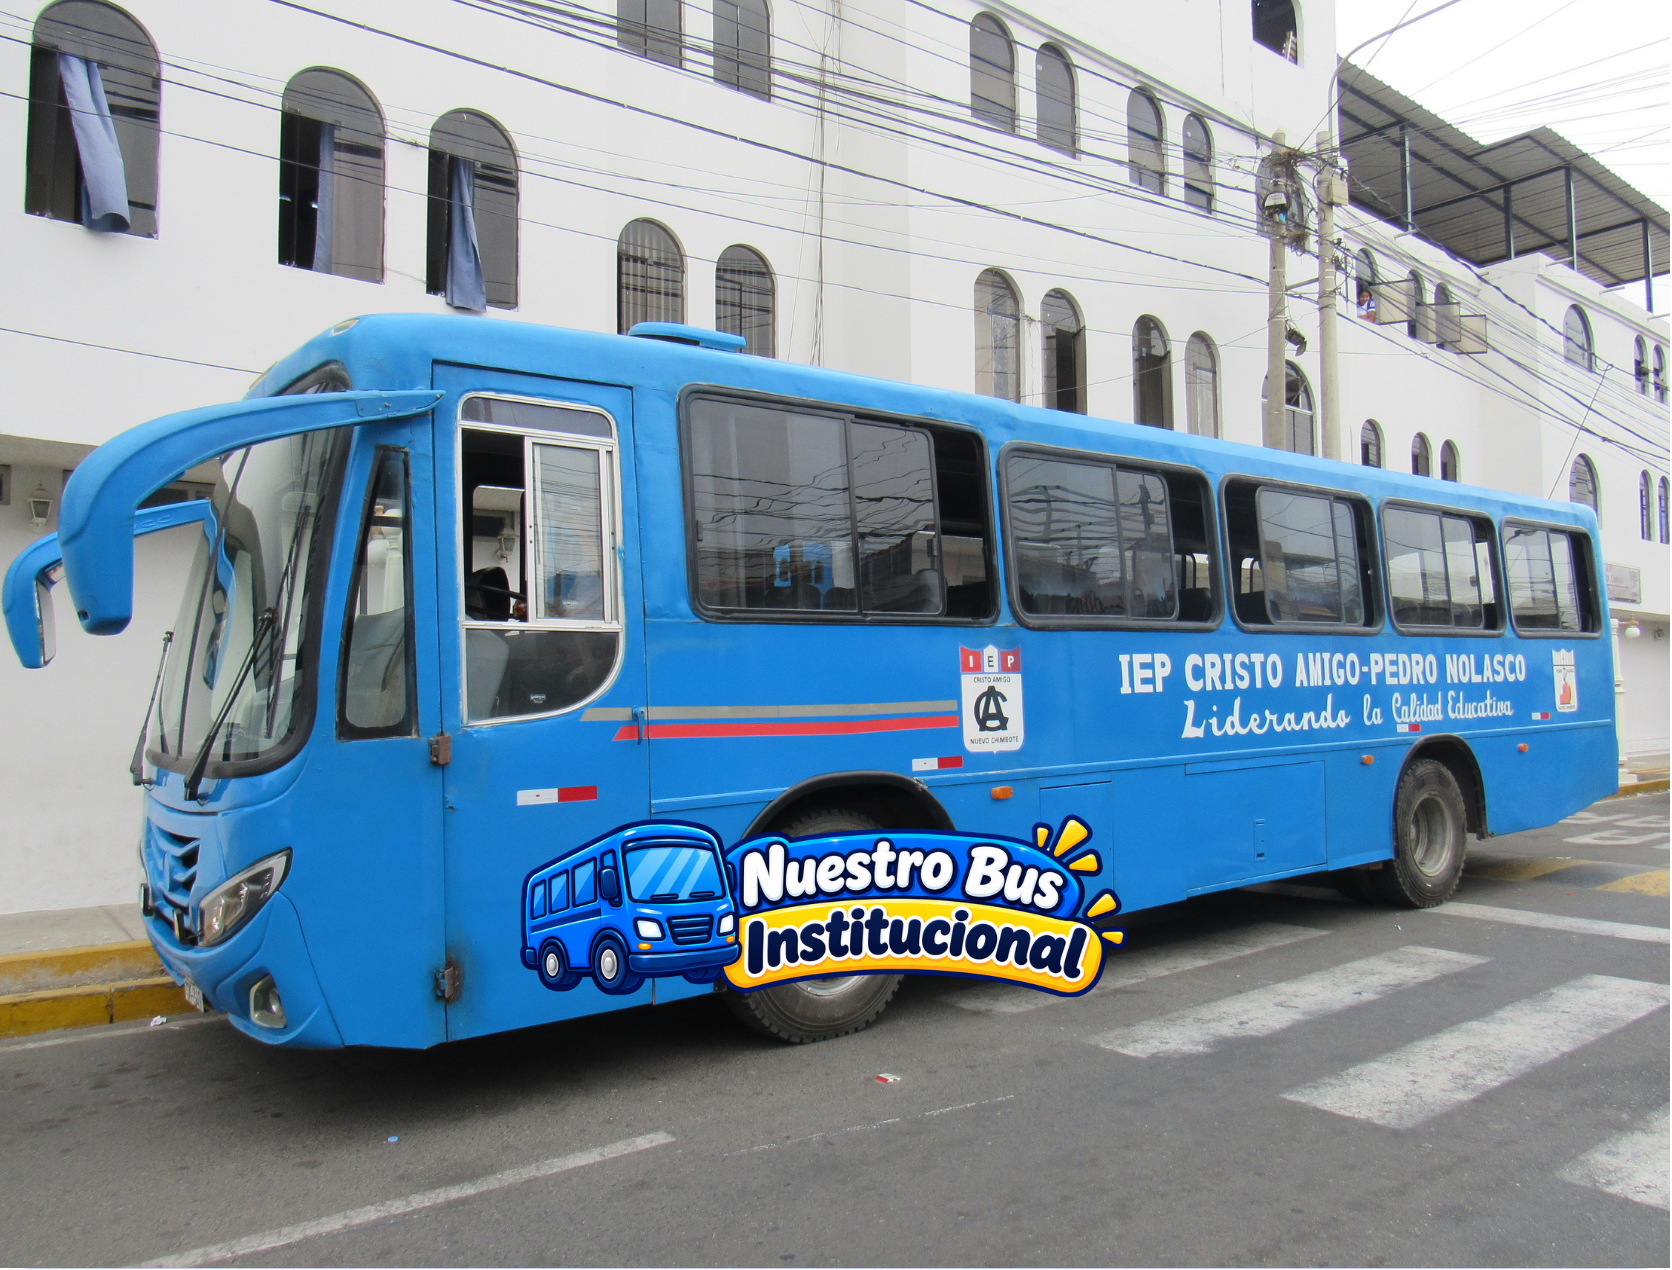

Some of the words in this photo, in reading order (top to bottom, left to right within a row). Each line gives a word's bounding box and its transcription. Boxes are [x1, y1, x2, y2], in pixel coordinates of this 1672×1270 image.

[973, 676, 992, 684] CRISTO
[1119, 653, 1172, 694] IEP
[1184, 652, 1283, 692] CRISTO
[1445, 653, 1527, 684] NOLASCO
[1181, 692, 1351, 739] Liderando
[1363, 694, 1383, 726] la
[1392, 691, 1444, 724] Calidad
[1447, 690, 1515, 719] Educativa
[991, 736, 1019, 744] CHIMBOTE
